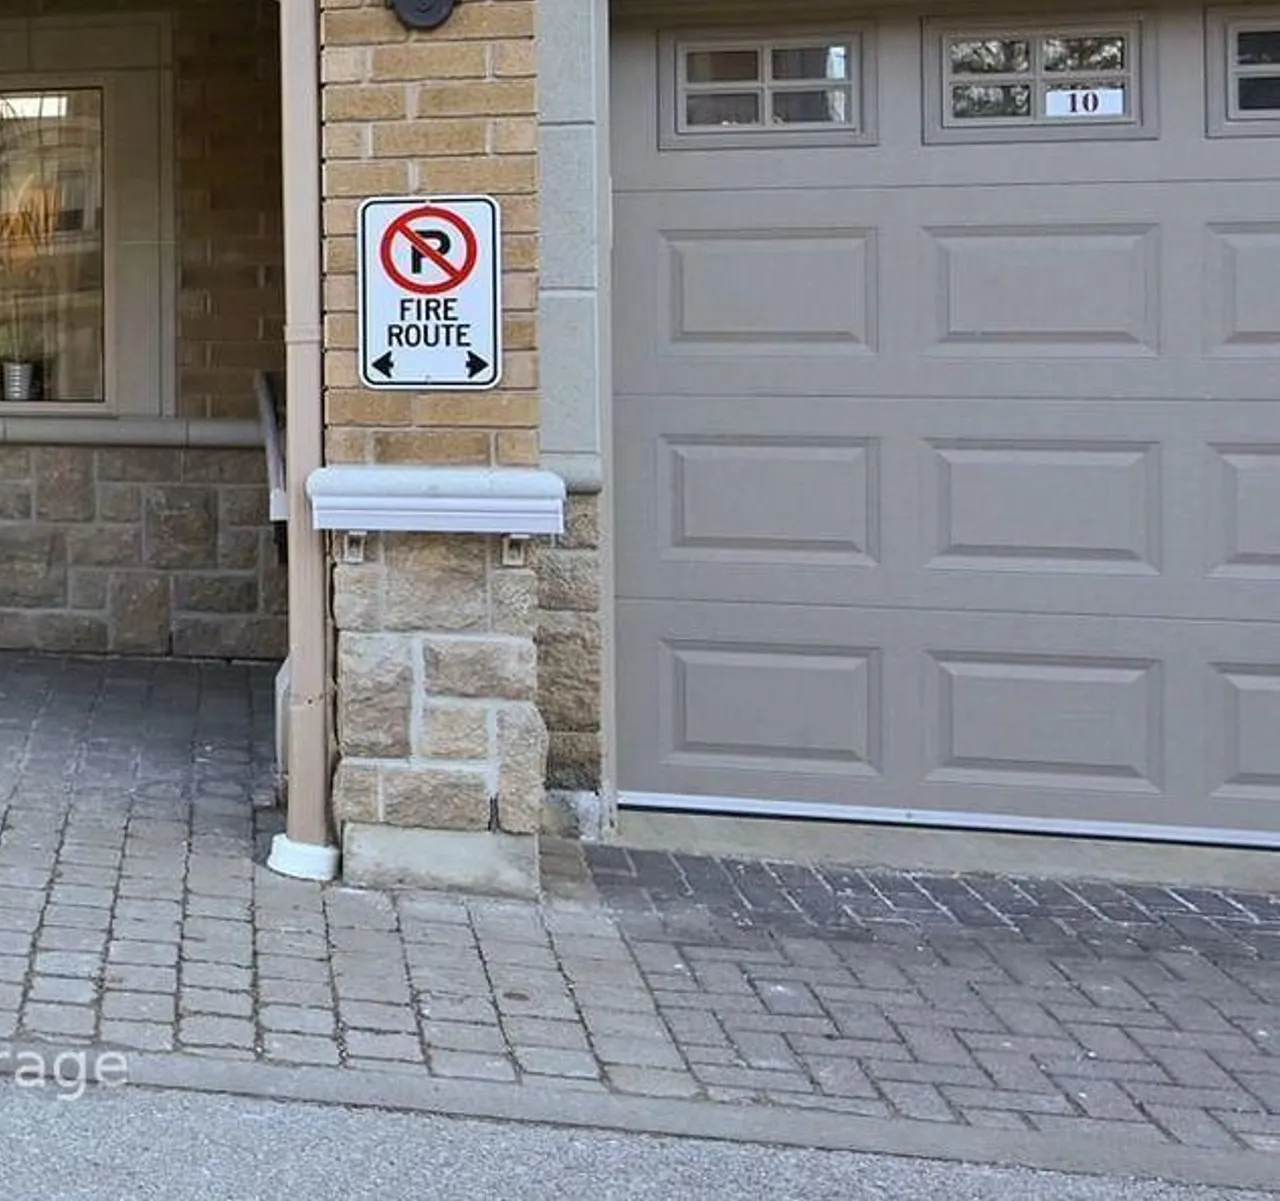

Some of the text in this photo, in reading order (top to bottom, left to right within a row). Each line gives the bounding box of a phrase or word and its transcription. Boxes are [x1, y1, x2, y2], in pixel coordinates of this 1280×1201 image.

[1069, 92, 1099, 112] 10
[400, 298, 458, 321] FIRE
[388, 324, 471, 347] ROUTE
